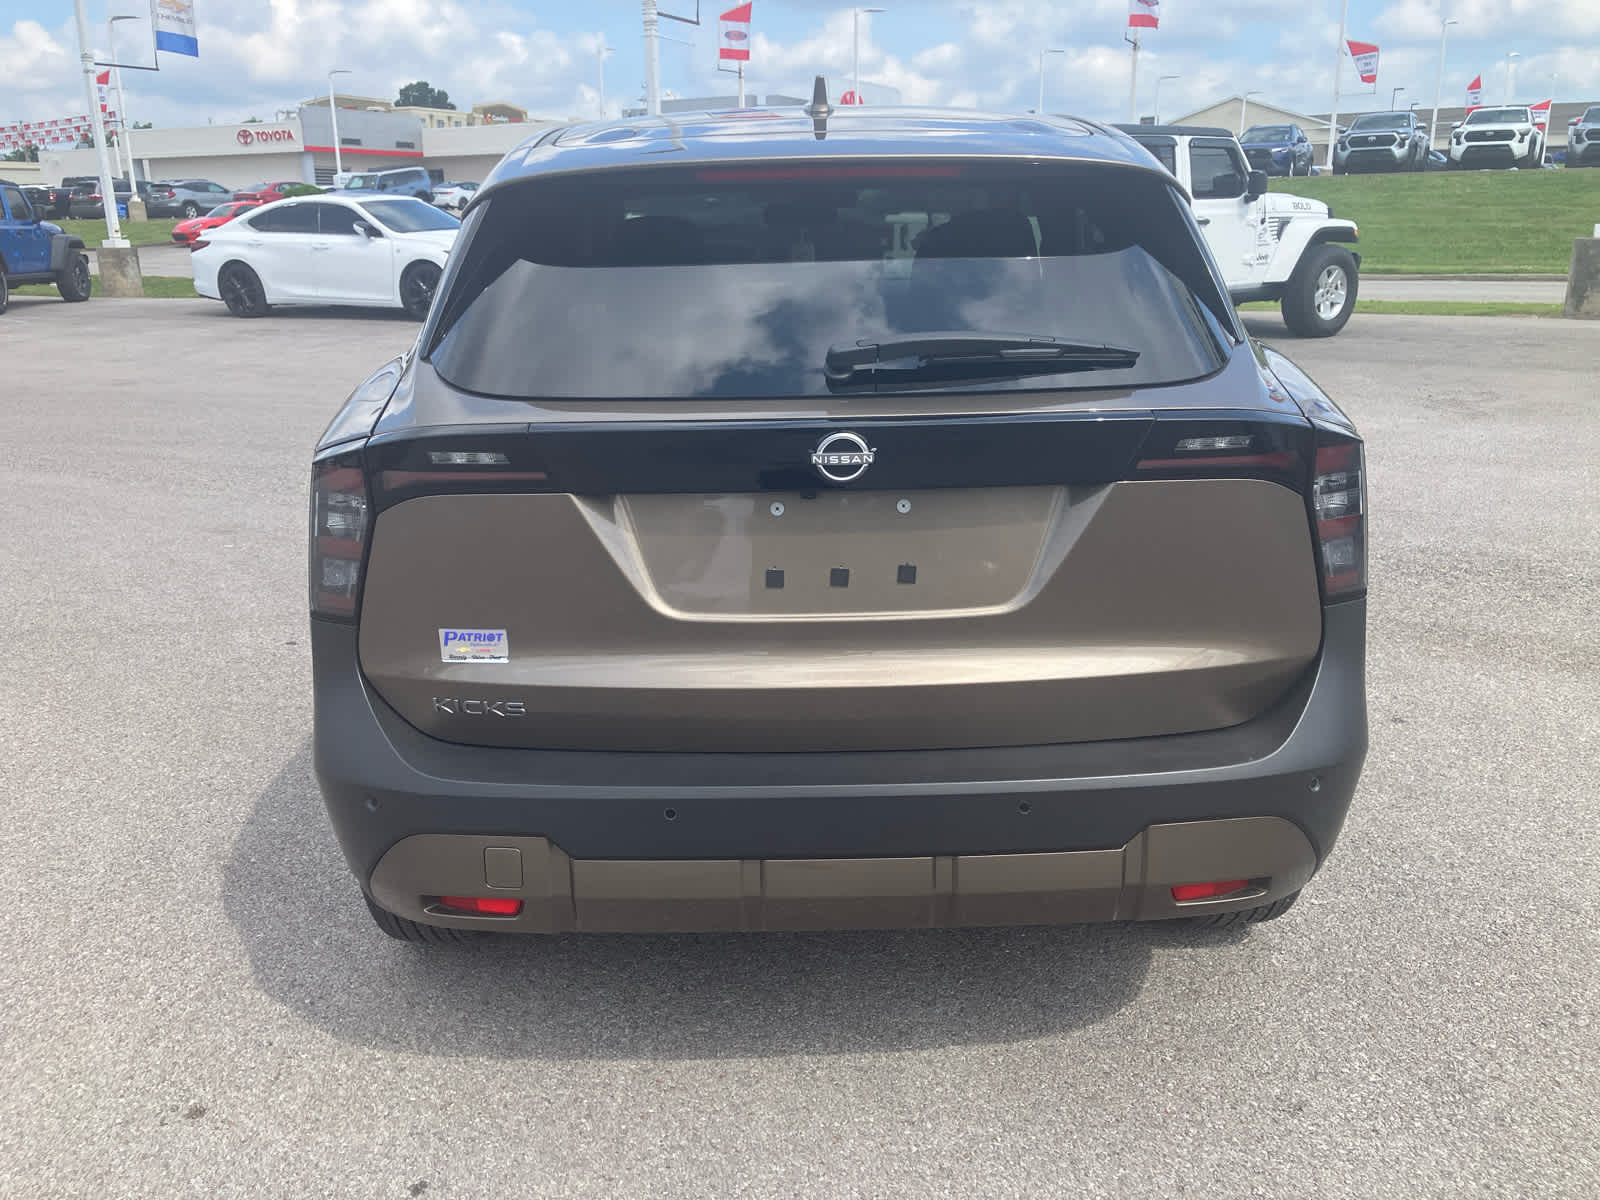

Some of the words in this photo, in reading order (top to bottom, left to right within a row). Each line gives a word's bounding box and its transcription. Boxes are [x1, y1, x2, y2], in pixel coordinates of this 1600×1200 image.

[255, 130, 294, 142] TOYOTA
[812, 455, 873, 464] NISSAN
[443, 631, 504, 647] PATRIOT
[433, 697, 526, 717] KICKS
